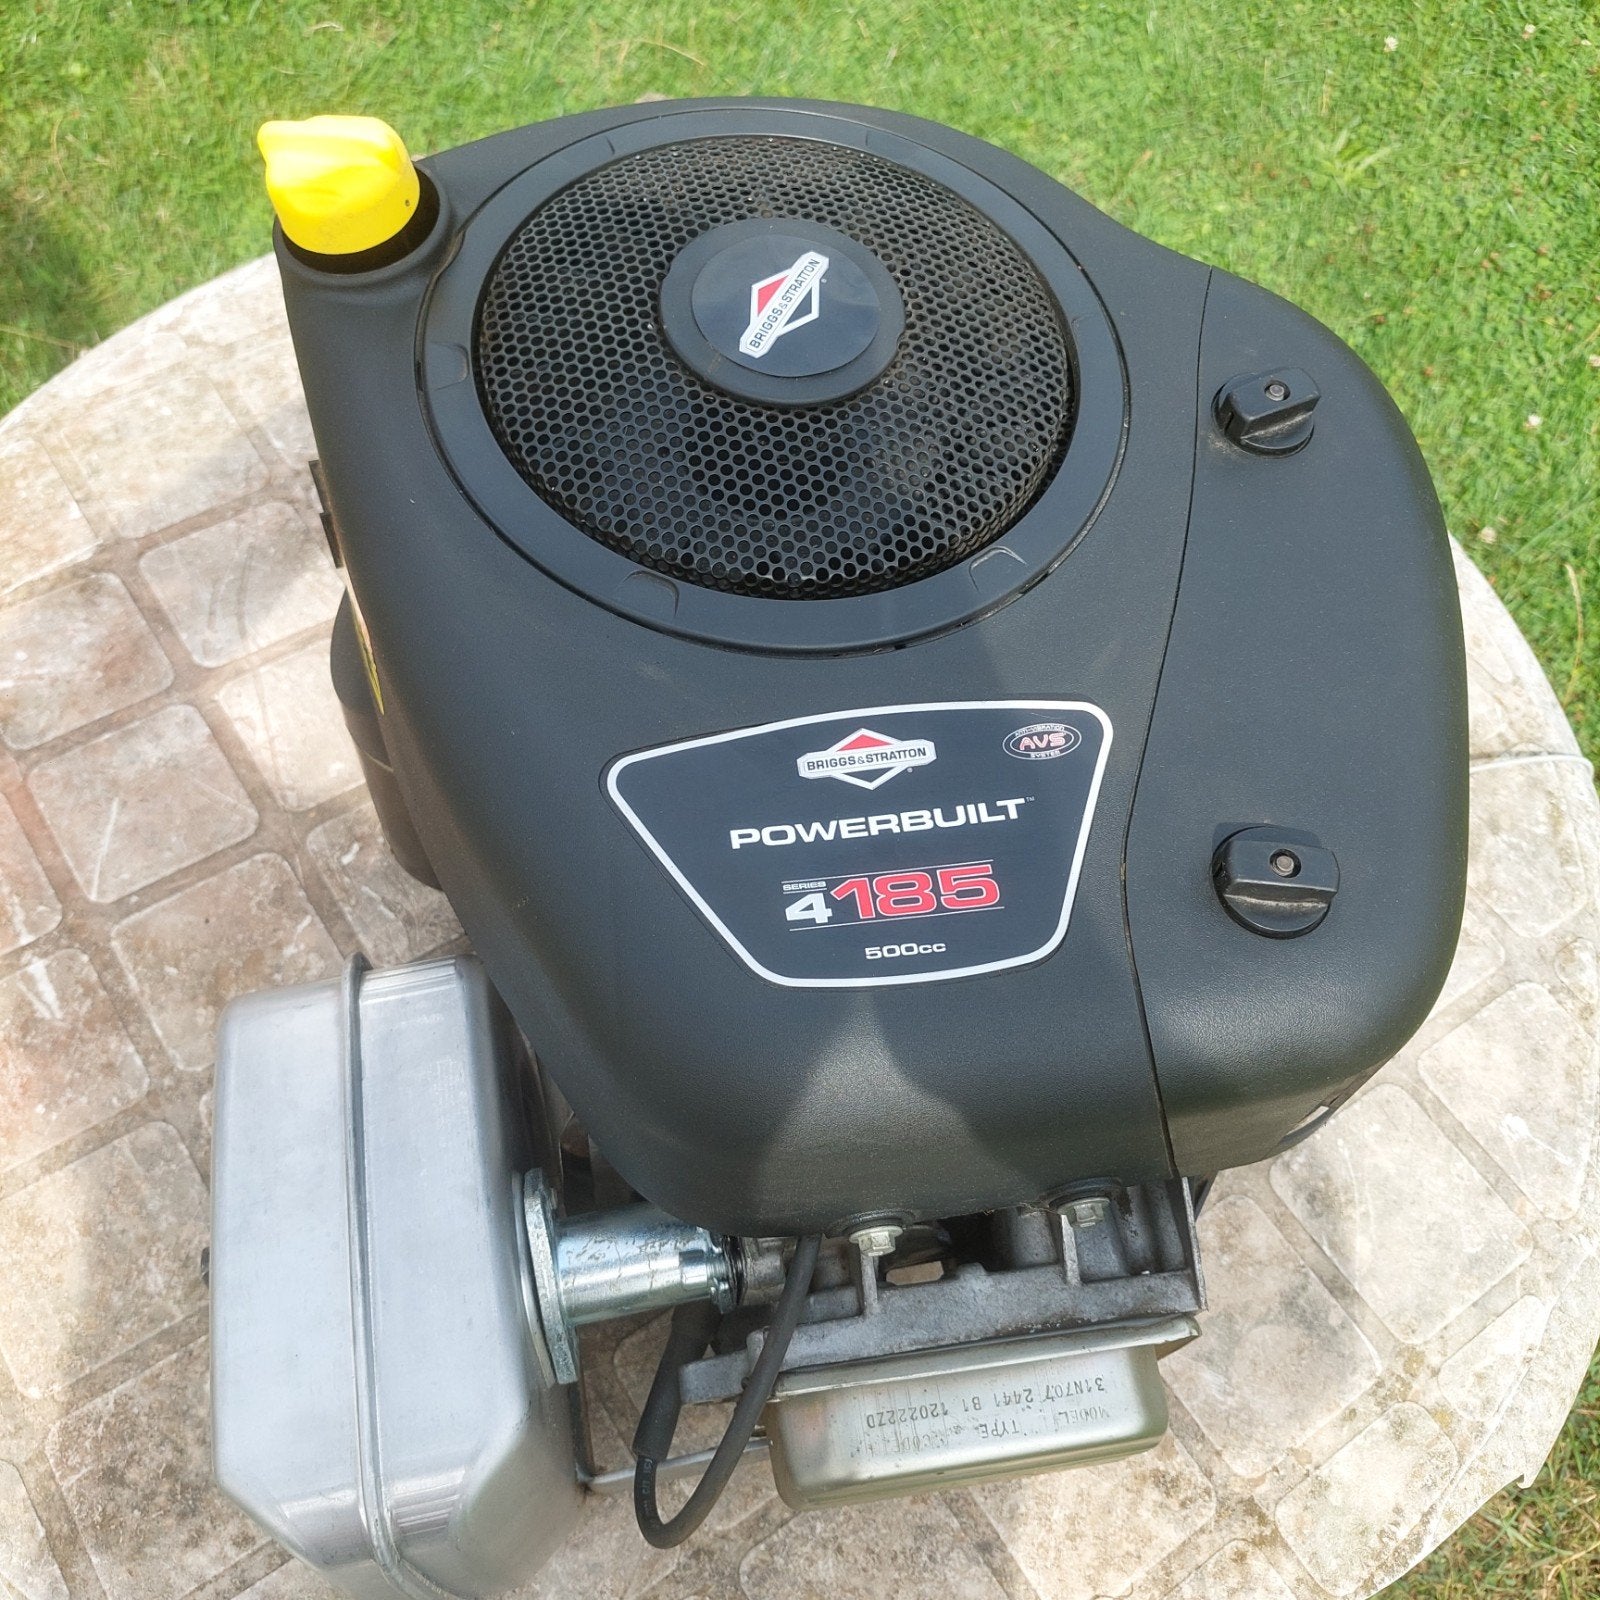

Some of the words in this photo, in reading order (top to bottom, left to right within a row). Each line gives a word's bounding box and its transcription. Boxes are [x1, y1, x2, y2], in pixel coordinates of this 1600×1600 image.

[1019, 732, 1066, 751] AVS
[729, 797, 1026, 849] POWERBUILT
[782, 880, 827, 892] SERIES
[865, 942, 947, 960] 500cc
[962, 1395, 982, 1413] B1
[993, 1387, 1034, 1408] 2441
[979, 1419, 1020, 1439] TYPE
